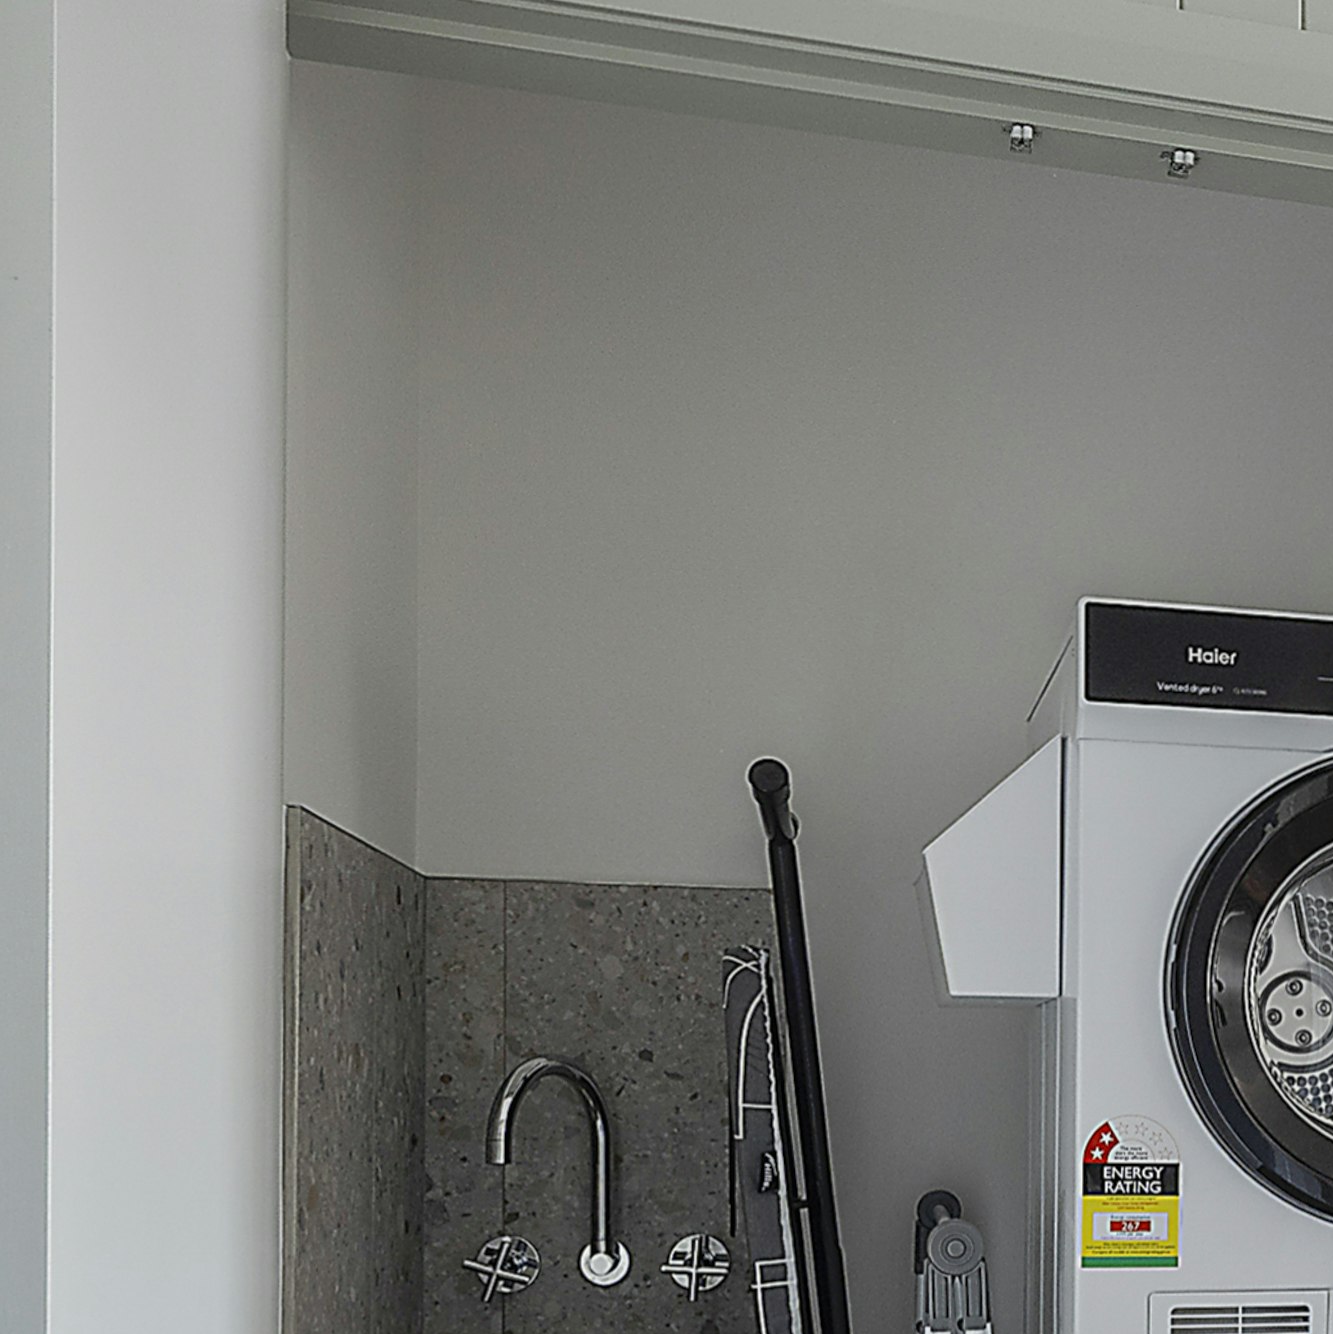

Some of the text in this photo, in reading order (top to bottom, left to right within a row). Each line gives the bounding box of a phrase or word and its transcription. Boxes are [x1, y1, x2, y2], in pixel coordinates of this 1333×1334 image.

[1188, 647, 1237, 665] Haier
[1157, 681, 1189, 693] Vented
[1103, 1166, 1164, 1180] ENERGY
[1104, 1180, 1162, 1194] RATING
